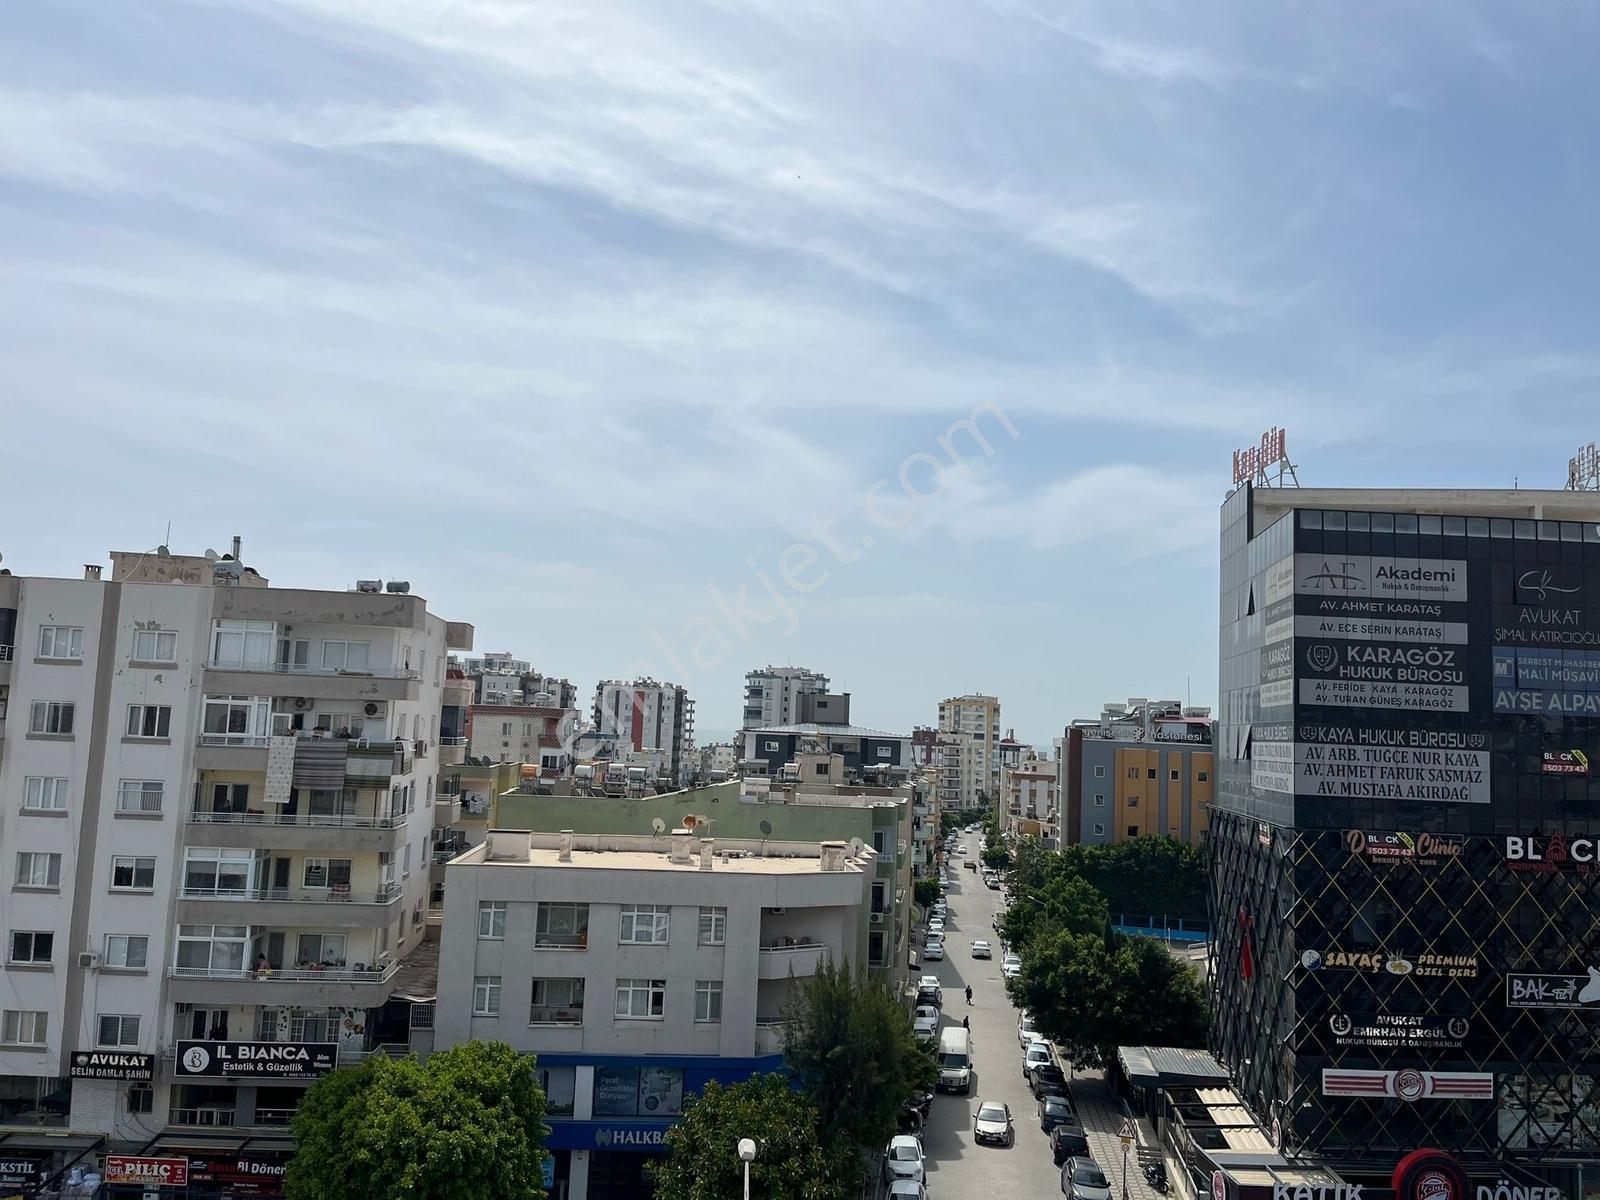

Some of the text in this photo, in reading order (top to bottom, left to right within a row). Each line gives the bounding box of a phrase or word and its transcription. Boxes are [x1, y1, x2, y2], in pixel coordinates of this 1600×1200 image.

[1376, 566, 1455, 582] Akademi
[1320, 601, 1442, 616] AV. AHMET KARATAŞ
[1519, 608, 1583, 625] AVUKAT
[1338, 623, 1358, 633] ECE
[1361, 624, 1392, 635] SERİN
[1395, 626, 1442, 639] KARATAŞ
[1494, 627, 1528, 642] ŞİMAL
[1347, 646, 1455, 667] KARAGÖZ
[1518, 657, 1552, 666] SERBEST
[1339, 665, 1463, 683] HUKUK BÜROSU
[1518, 667, 1600, 683] MALİ MÜŞAVİ
[1333, 682, 1366, 692] FERİDE
[1372, 685, 1397, 694] KAYA
[1404, 687, 1453, 697] KARAGÖZ
[1333, 694, 1366, 704] TURAN
[1369, 696, 1402, 707] GÜNEŞ
[1404, 698, 1453, 708] KARAGÖZ
[1495, 691, 1543, 711] AYŞE
[1318, 727, 1466, 748] KAYA HUKUK BÜROSU
[1305, 747, 1325, 760] AV.
[1328, 747, 1360, 762] ARB.
[1363, 748, 1409, 764] TUĞÇE
[1412, 751, 1441, 765] NUR
[1445, 753, 1480, 767] KAYA
[1543, 752, 1573, 761] BLCK
[1304, 763, 1323, 776] AV.
[1326, 764, 1376, 778] AHMET
[1379, 766, 1425, 780] FARUK
[1317, 781, 1337, 795] AV.
[1340, 782, 1403, 798] MUSTAFA
[1367, 835, 1399, 844] BLCK
[1506, 836, 1600, 862] BLC
[1325, 952, 1383, 974] SAYAÇ
[1415, 965, 1477, 977] ÖZEL DERS
[1375, 1015, 1424, 1025] AVUKAT
[1409, 1027, 1447, 1038] ERGÜL
[1336, 1037, 1365, 1045] HUKUK
[90, 1054, 148, 1067] AVUKAT
[238, 1046, 310, 1060] BIANCA
[71, 1066, 151, 1080] SELİN DAMLA ŞAHİN
[223, 1062, 303, 1072] Estetik & Güzellik
[124, 1160, 171, 1178] PİLİÇ
[251, 1163, 287, 1175] Döner
